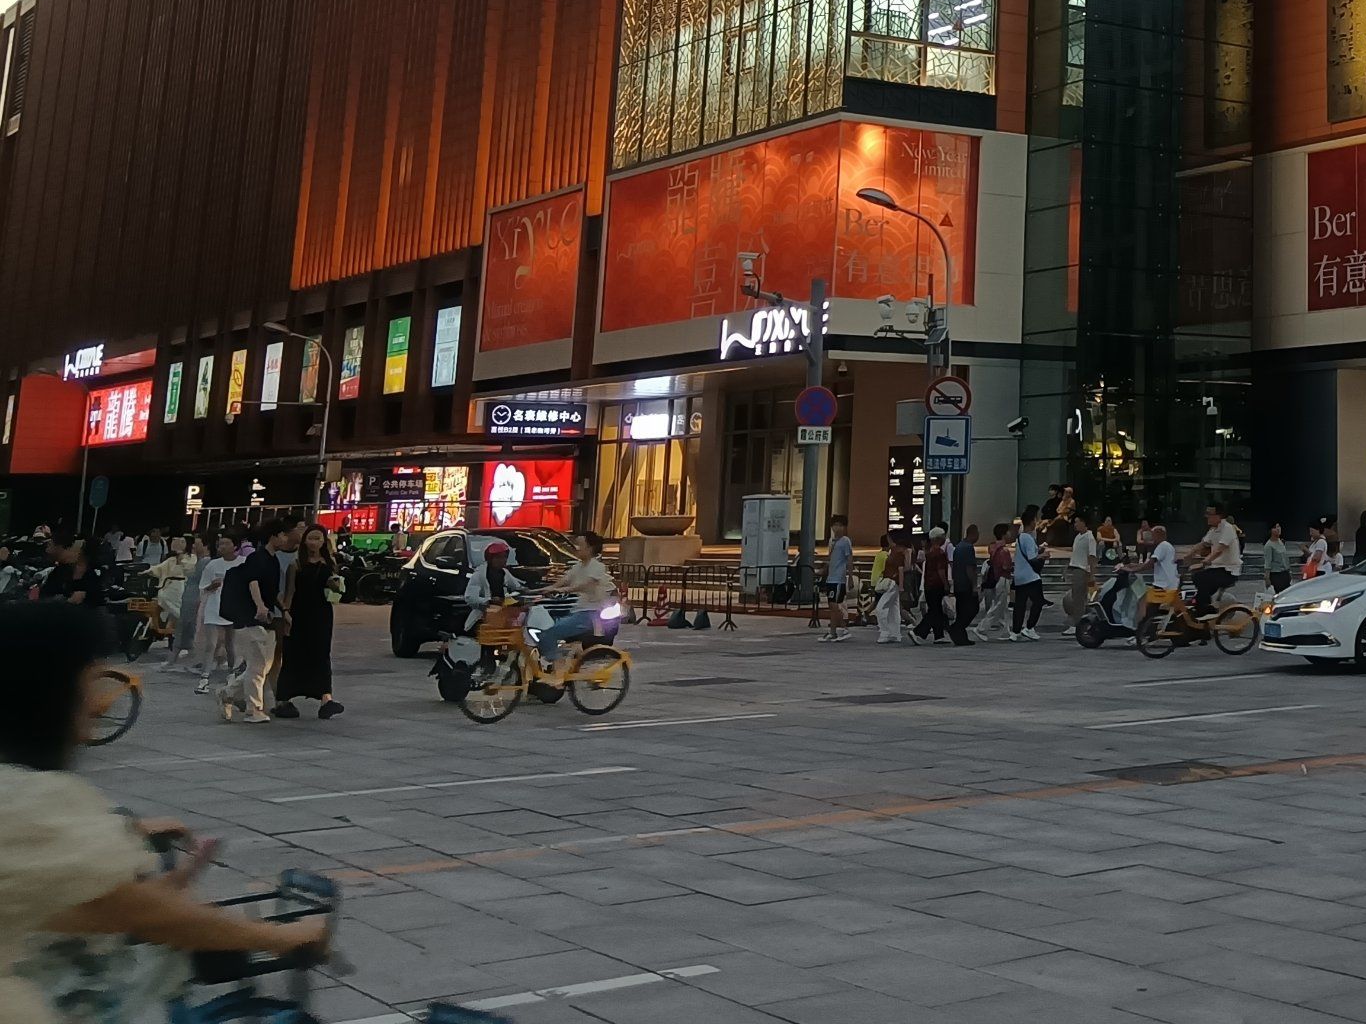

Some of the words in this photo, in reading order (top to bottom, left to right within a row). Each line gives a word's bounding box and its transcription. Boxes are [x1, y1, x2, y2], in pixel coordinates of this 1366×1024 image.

[938, 146, 968, 163] Year
[1313, 205, 1356, 240] Ber
[382, 479, 424, 489] 公共停车场
[187, 486, 200, 499] P
